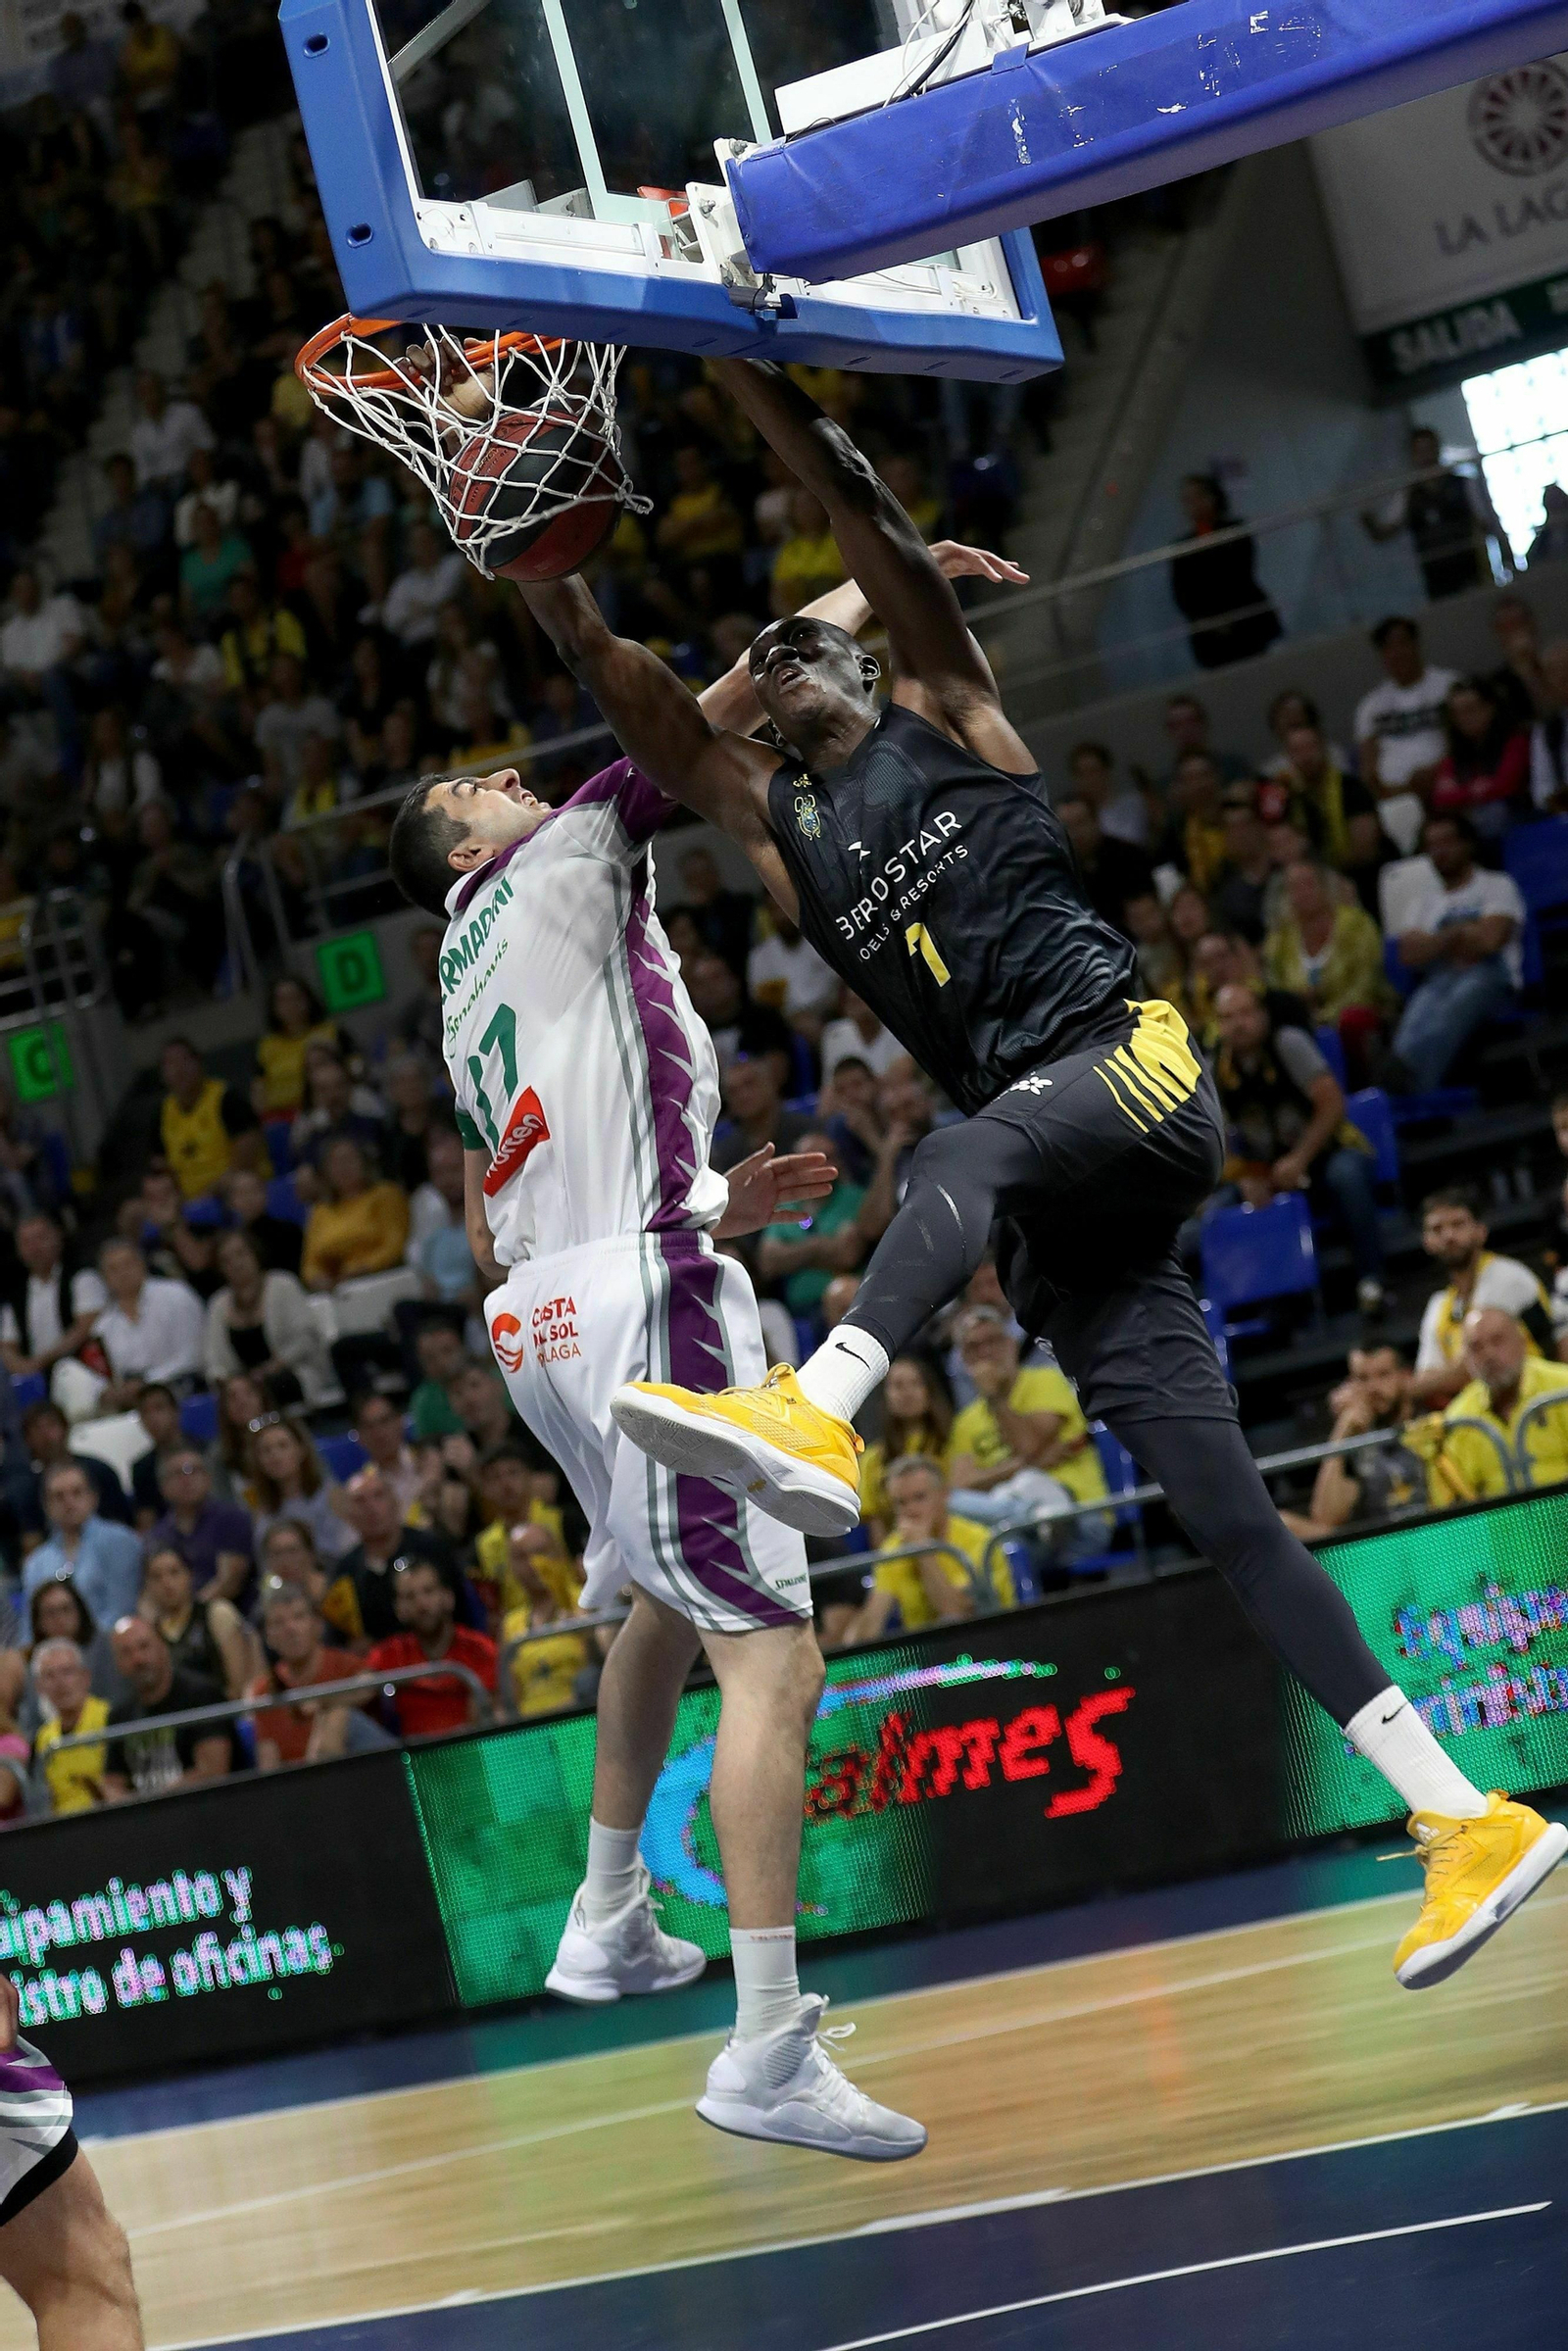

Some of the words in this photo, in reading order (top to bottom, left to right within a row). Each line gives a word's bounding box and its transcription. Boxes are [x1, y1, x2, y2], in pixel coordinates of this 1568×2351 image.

[337, 952, 367, 993] D
[550, 1322, 579, 1342] SOL
[221, 1866, 252, 1923] y
[112, 1947, 169, 2008] de
[170, 1921, 333, 1997] oficinas
